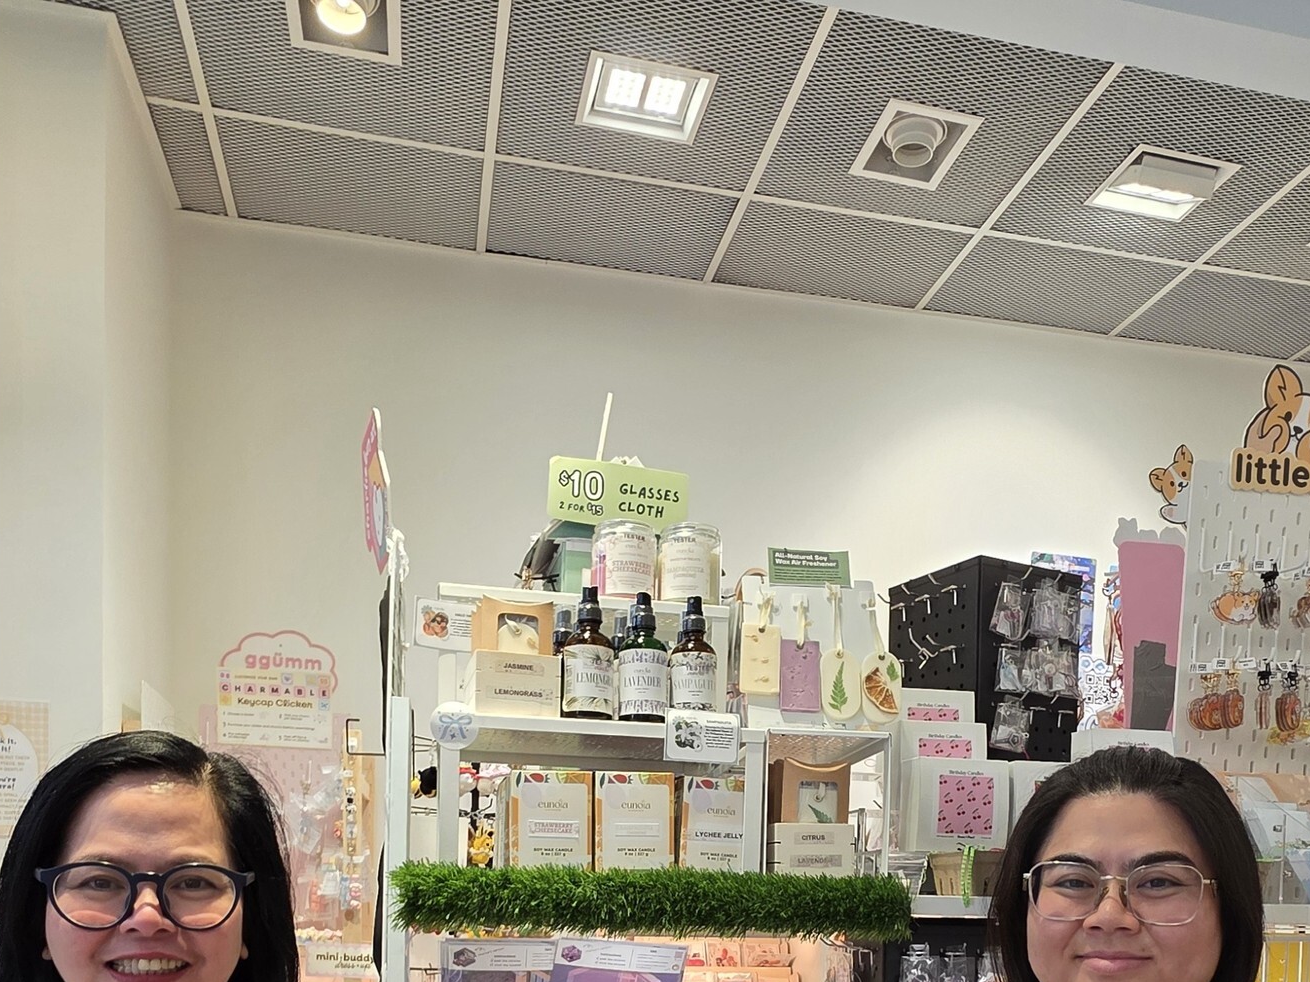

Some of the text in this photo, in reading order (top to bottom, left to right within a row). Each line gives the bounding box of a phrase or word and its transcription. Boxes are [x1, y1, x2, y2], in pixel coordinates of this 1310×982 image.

[559, 470, 604, 501] $10
[619, 483, 680, 503] GLASSES
[559, 501, 565, 509] 2
[567, 503, 585, 512] FOR
[618, 502, 664, 518] CLOTH
[775, 552, 813, 561] All-Natural
[503, 663, 534, 671] JASMINE
[494, 688, 543, 698] LEMONGRASS
[316, 952, 339, 961] mini
